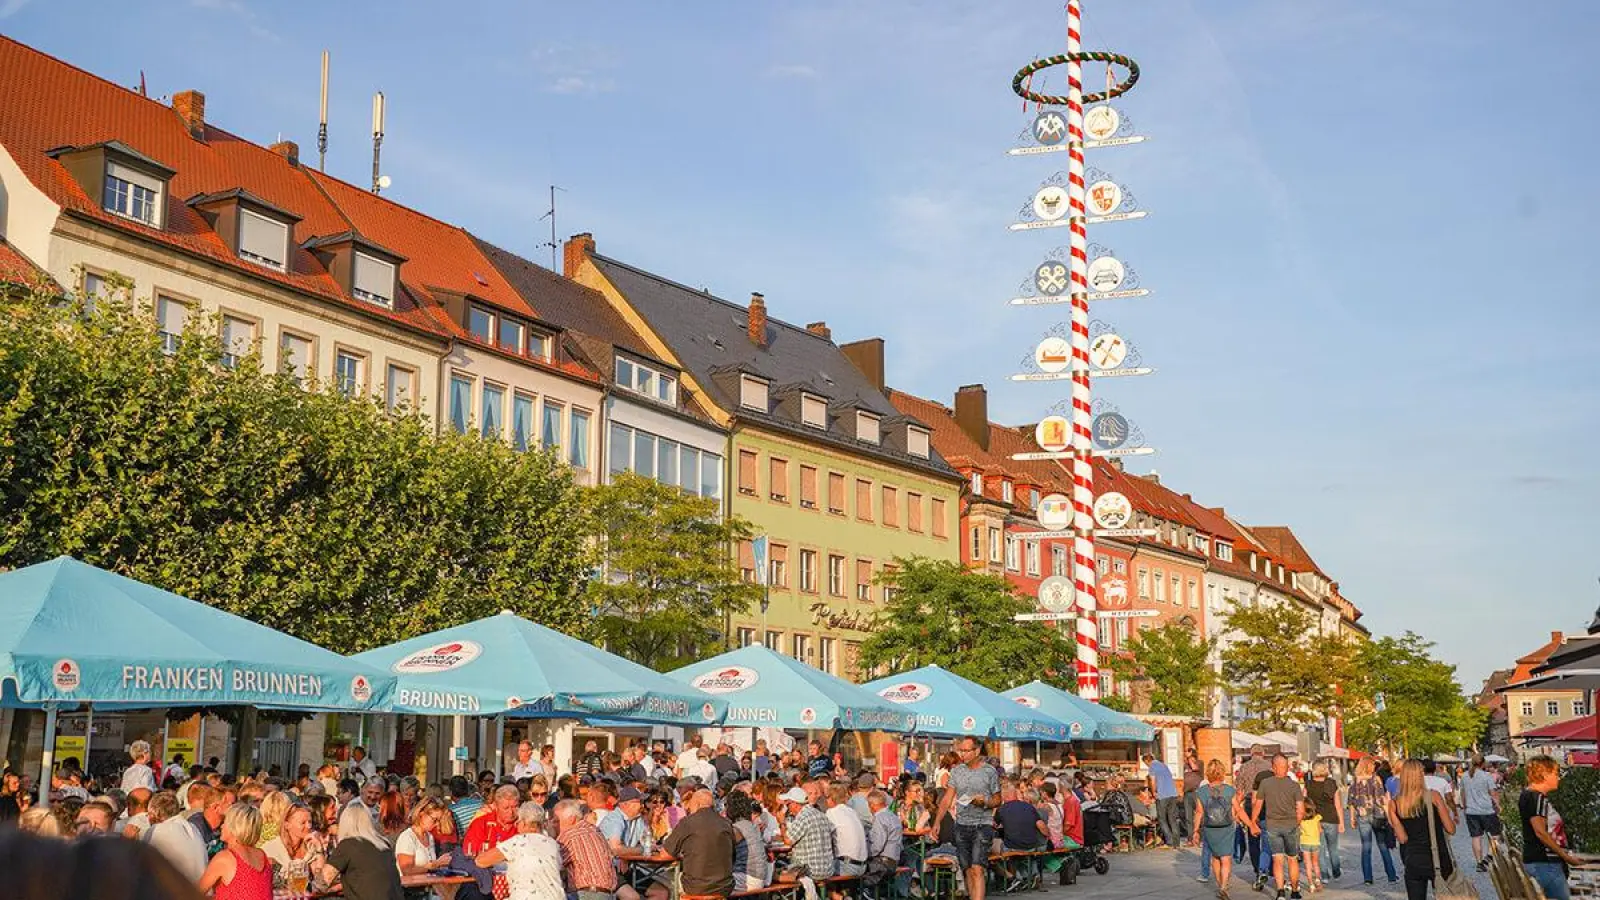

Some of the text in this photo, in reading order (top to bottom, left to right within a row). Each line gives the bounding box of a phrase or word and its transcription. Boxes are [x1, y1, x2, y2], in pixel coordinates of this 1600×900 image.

[122, 665, 321, 696] FRANKEN BRUNNEN
[400, 689, 480, 711] BRUNNEN
